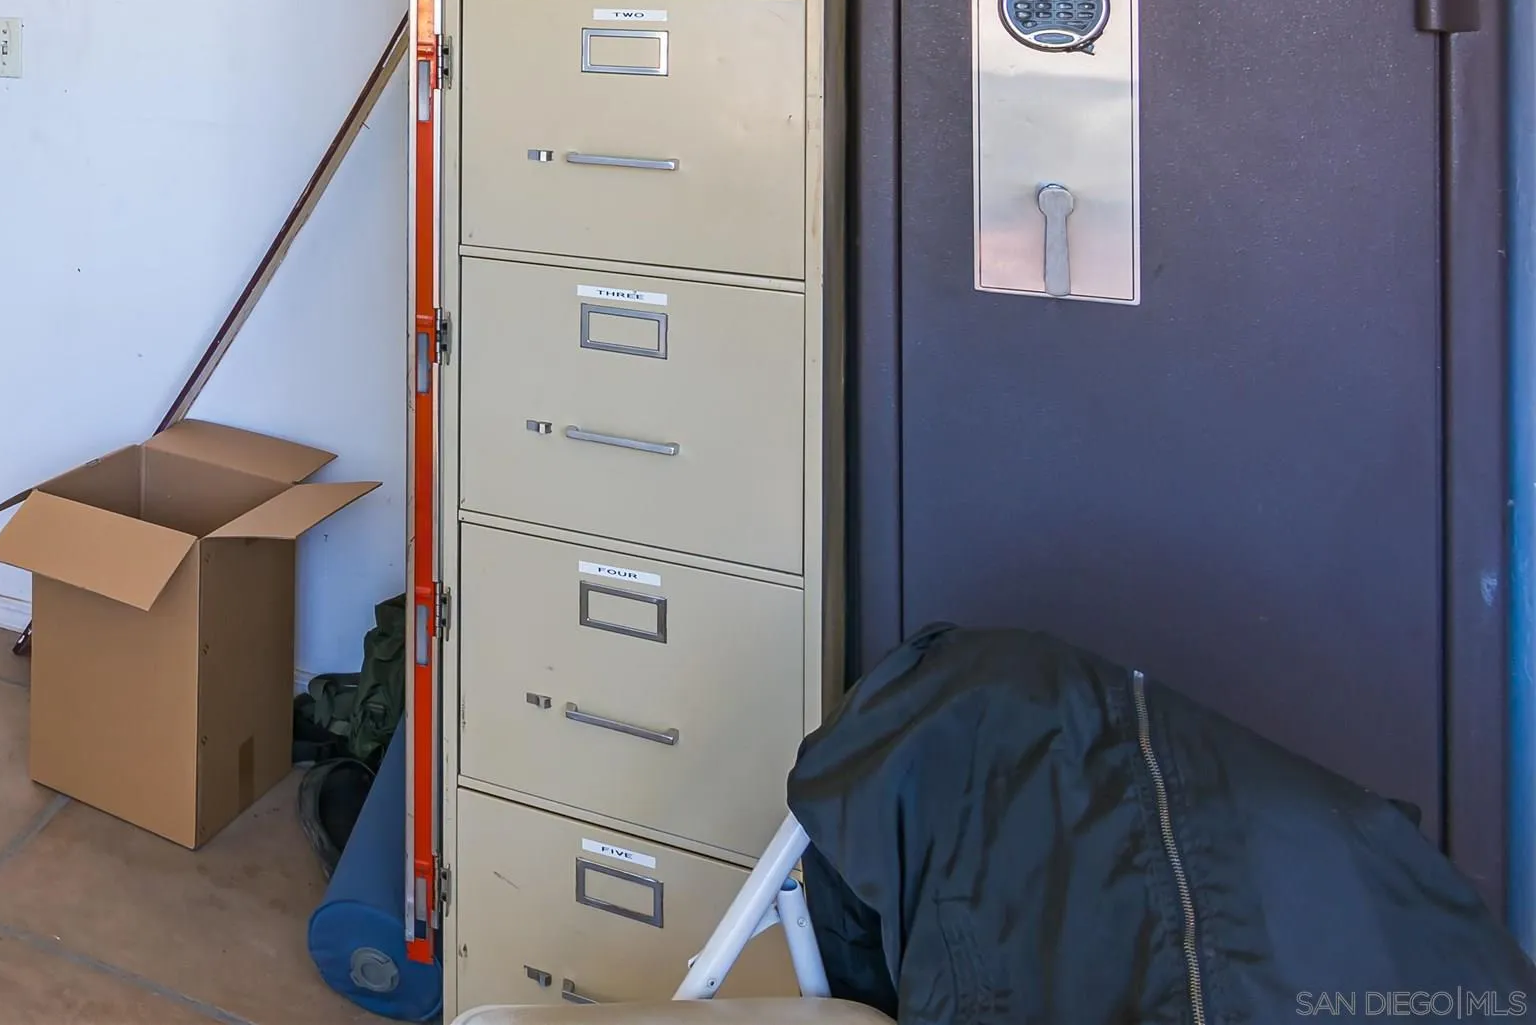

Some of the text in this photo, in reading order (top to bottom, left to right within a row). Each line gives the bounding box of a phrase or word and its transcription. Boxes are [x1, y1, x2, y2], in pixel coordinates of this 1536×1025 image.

[596, 289, 645, 300] THREE
[598, 567, 638, 579] FOUR
[601, 846, 633, 859] FIVE
